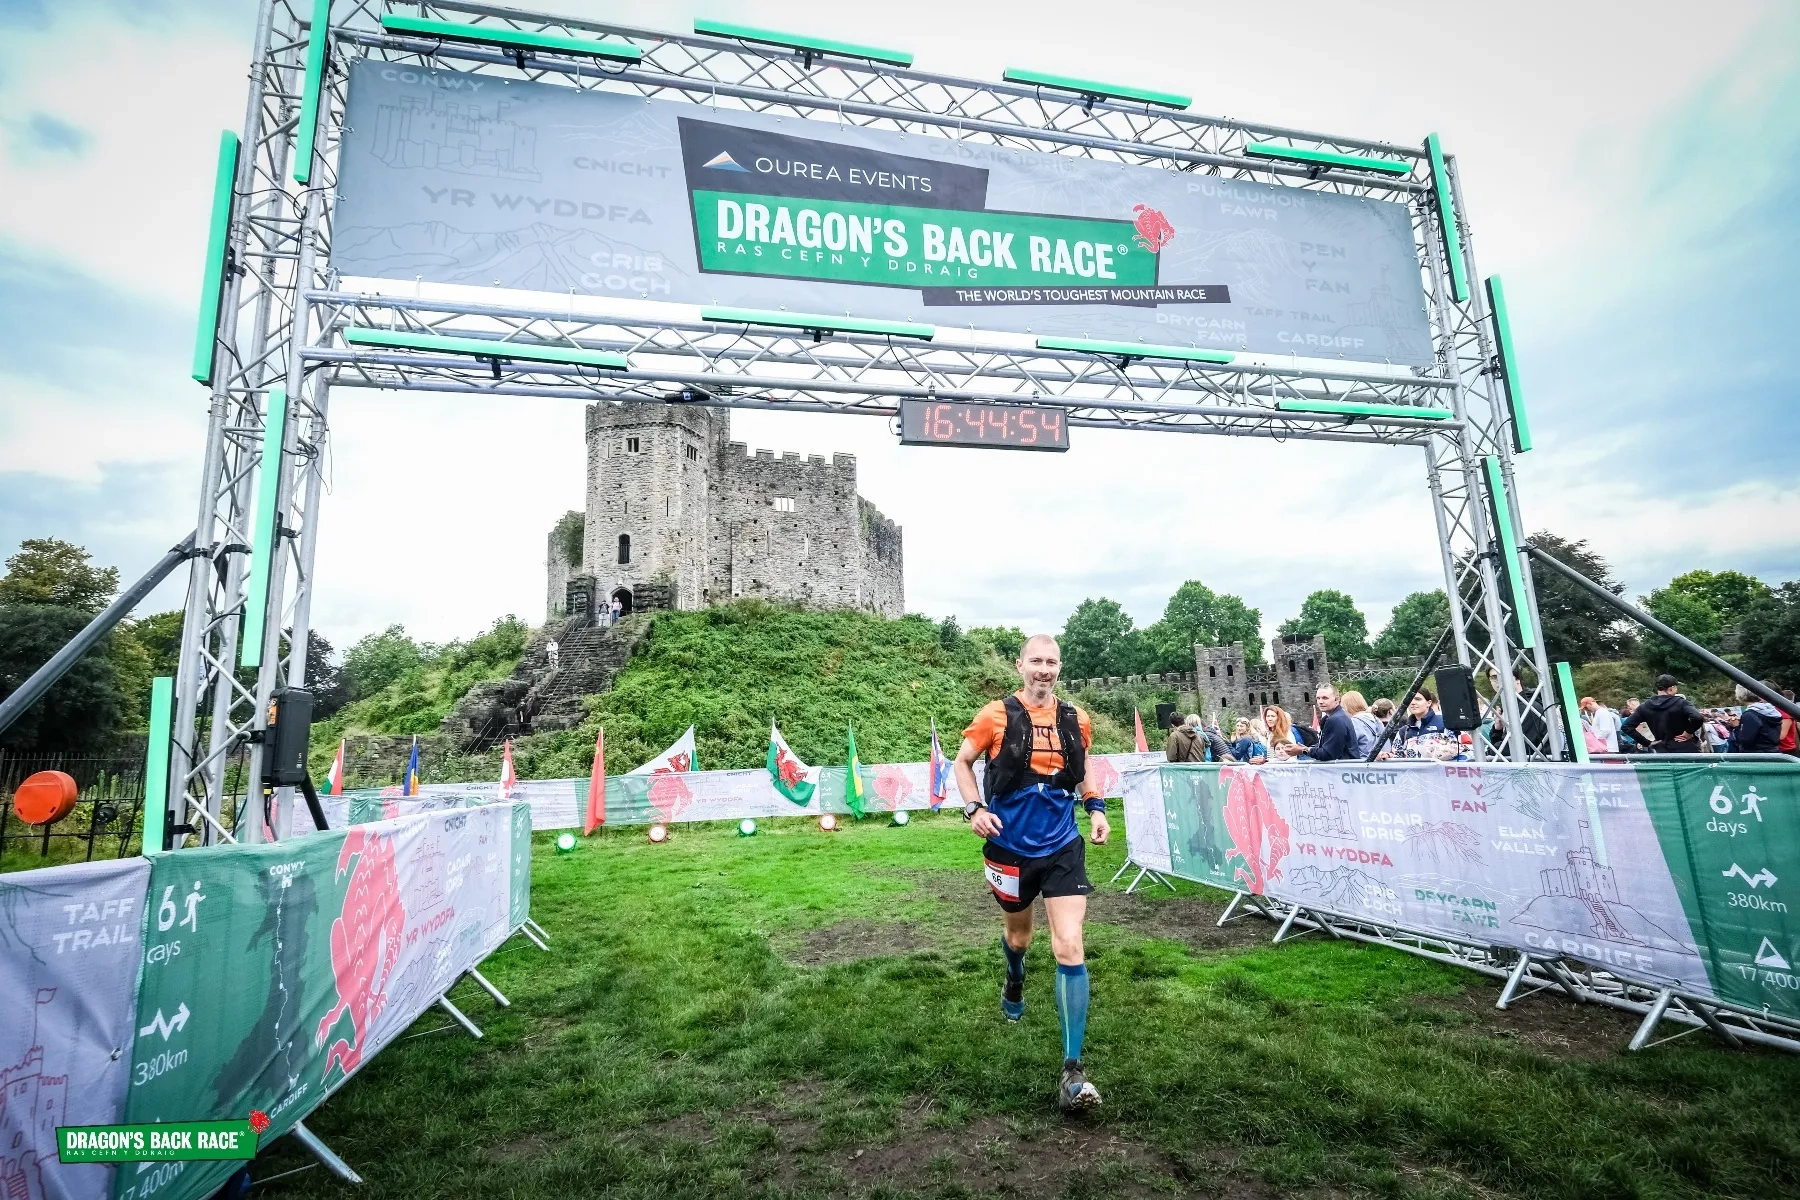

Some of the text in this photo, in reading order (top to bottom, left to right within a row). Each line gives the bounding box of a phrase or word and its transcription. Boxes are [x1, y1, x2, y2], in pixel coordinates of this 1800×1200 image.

[380, 68, 485, 92] CONWY
[928, 143, 1010, 164] CADAIR
[572, 156, 672, 179] CNICHT
[755, 157, 933, 193] OUREA EVENTS
[422, 185, 653, 225] YR WYDDFA
[1186, 182, 1306, 209] PUMLUMON
[1221, 203, 1278, 221] FAWR
[717, 199, 909, 257] DRAGON'S
[922, 223, 1018, 270] BACK
[717, 241, 979, 279] RAS CEFN Y DDRAIG
[1299, 241, 1347, 259] PEN
[590, 251, 662, 271] CRIB
[1302, 260, 1316, 273] Y
[580, 272, 671, 295] GOCH
[1305, 278, 1350, 294] FAN
[956, 289, 1206, 302] THE WORLD'S TOUGHEST MOUNTAIN RACE
[1155, 312, 1246, 331] DRYGARN
[1243, 306, 1336, 324] TAFF TRAIL
[1198, 329, 1248, 344] FAWR
[1277, 331, 1364, 349] CARDIFF
[924, 404, 1060, 444] 16:44:54
[1341, 772, 1398, 785] CNICHT
[1444, 766, 1482, 778] PEN
[1470, 783, 1484, 795] Y
[1575, 782, 1622, 794] TAFF
[1451, 800, 1487, 813] FAN
[1574, 795, 1629, 808] TAIL
[1709, 785, 1733, 815] 6
[1358, 810, 1423, 827] CADAIR
[1706, 816, 1747, 837] days
[1361, 826, 1405, 842] IDRIS
[1498, 825, 1545, 840] ELAN
[1296, 842, 1394, 867] YR WYDDFA
[1490, 840, 1558, 857] VALLEY
[269, 860, 306, 876] CONWY
[1364, 884, 1397, 899] CRIB
[63, 897, 136, 925] TAFF
[158, 885, 176, 932] 6
[1363, 897, 1402, 915] GOCH
[1727, 892, 1788, 914] 380km
[406, 926, 418, 948] YR
[421, 905, 455, 937] WYDDFA
[1452, 909, 1500, 929] FAWR
[52, 925, 134, 955] TRAIL
[1524, 931, 1654, 971] CARDIFF
[1739, 965, 1800, 990] 17,400
[134, 1049, 188, 1086] 380km
[270, 1083, 308, 1119] CARDIFF
